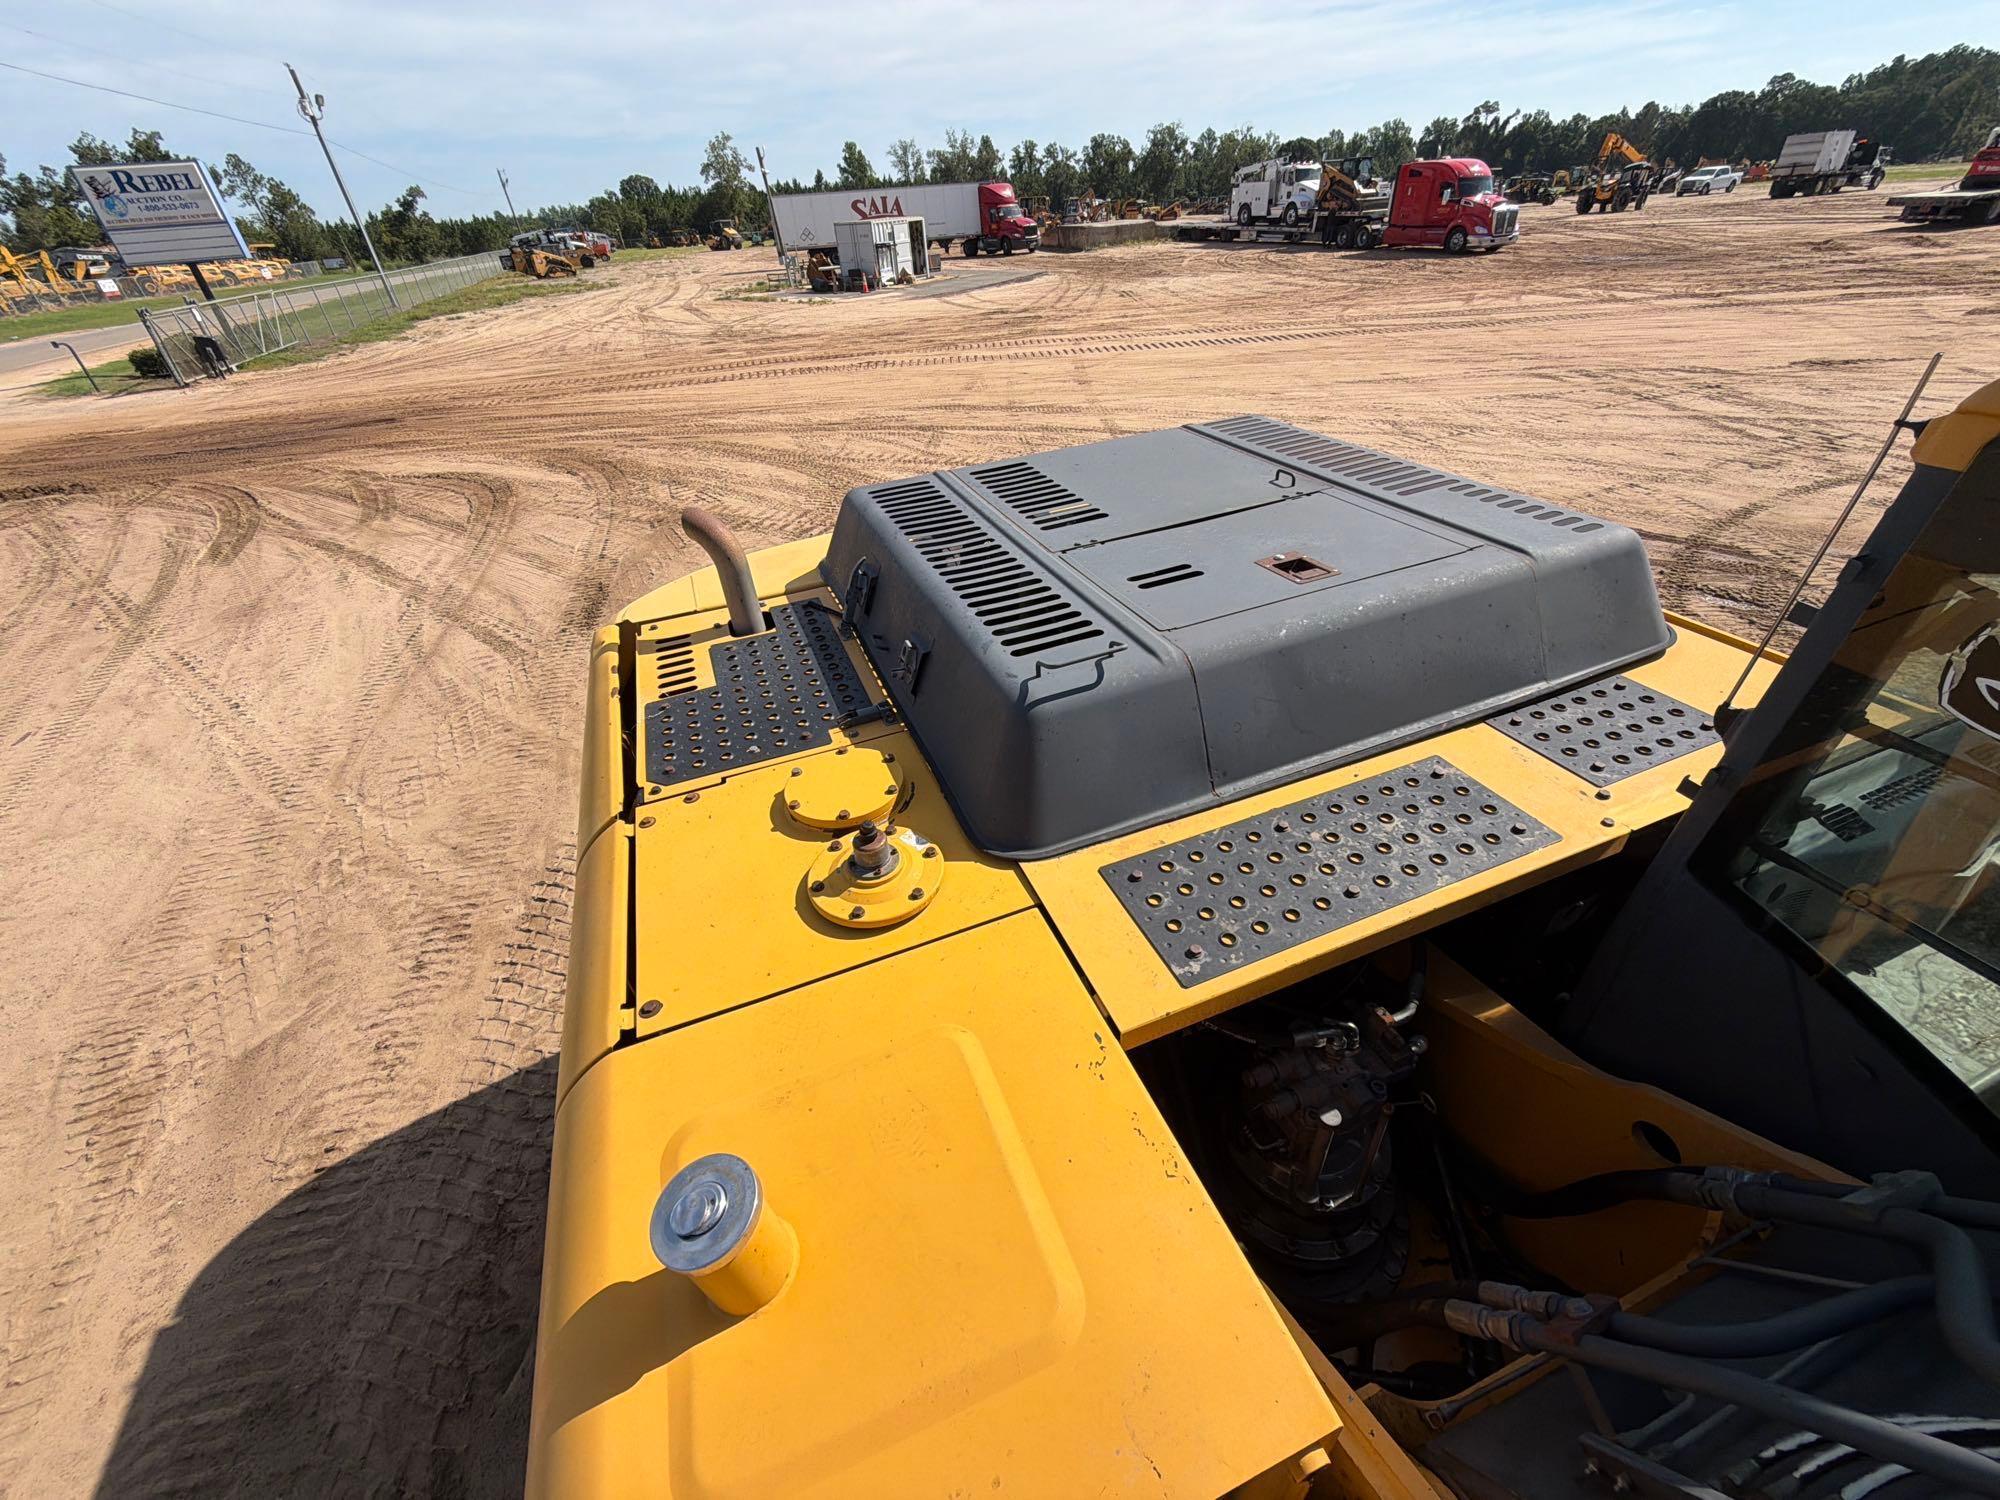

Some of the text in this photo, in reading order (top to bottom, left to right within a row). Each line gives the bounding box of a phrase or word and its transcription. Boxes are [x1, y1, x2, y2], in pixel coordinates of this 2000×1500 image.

[108, 170, 201, 194] REBEL
[127, 194, 185, 205] AUCTION CO.
[138, 202, 200, 213] 1-800-533-0673
[851, 195, 904, 219] SAIA
